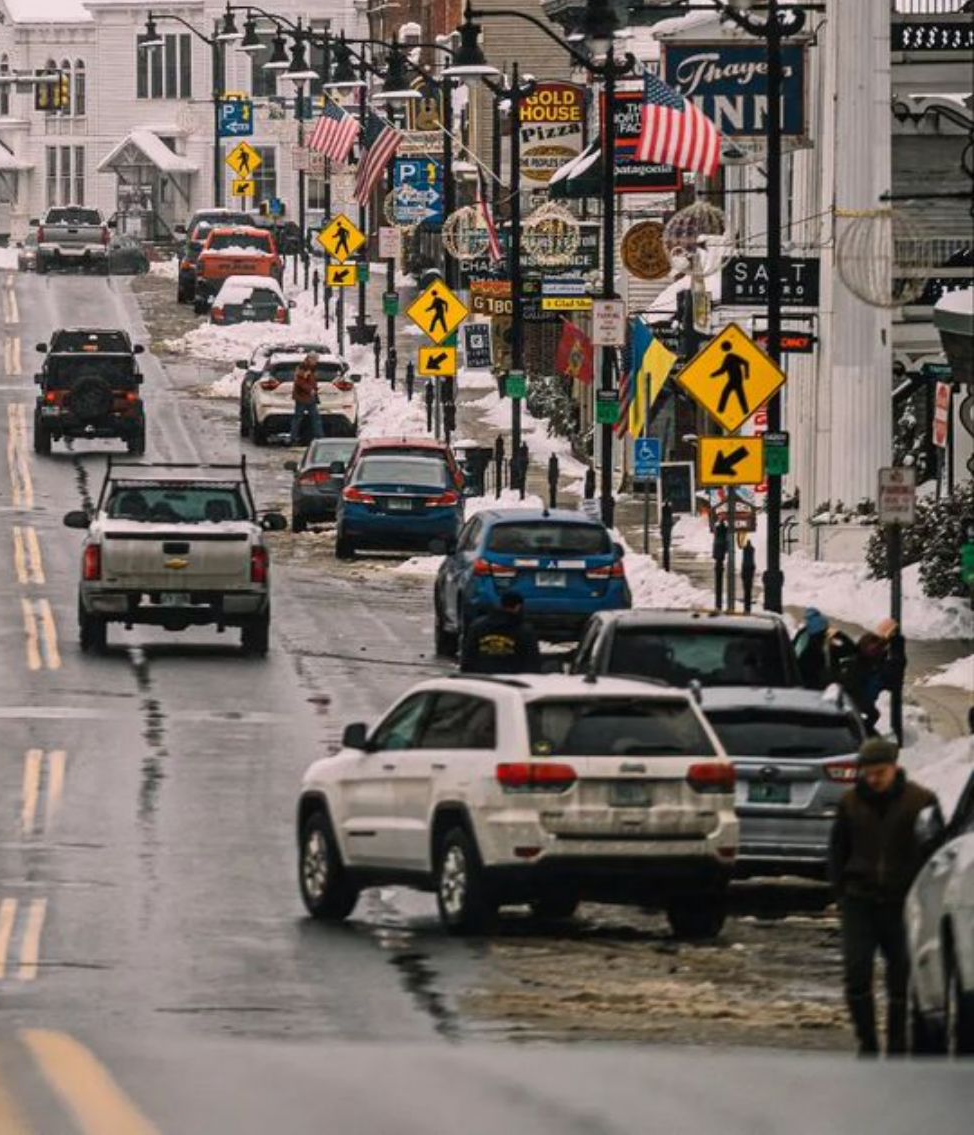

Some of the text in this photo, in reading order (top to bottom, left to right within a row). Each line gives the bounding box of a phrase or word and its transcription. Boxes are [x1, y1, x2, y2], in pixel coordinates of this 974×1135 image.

[526, 90, 575, 104] GOLD
[223, 105, 234, 119] P
[519, 106, 581, 121] HOUSE
[521, 124, 581, 143] Pizza
[400, 164, 416, 181] P
[734, 262, 806, 282] SAT
[735, 285, 804, 296] BISRO
